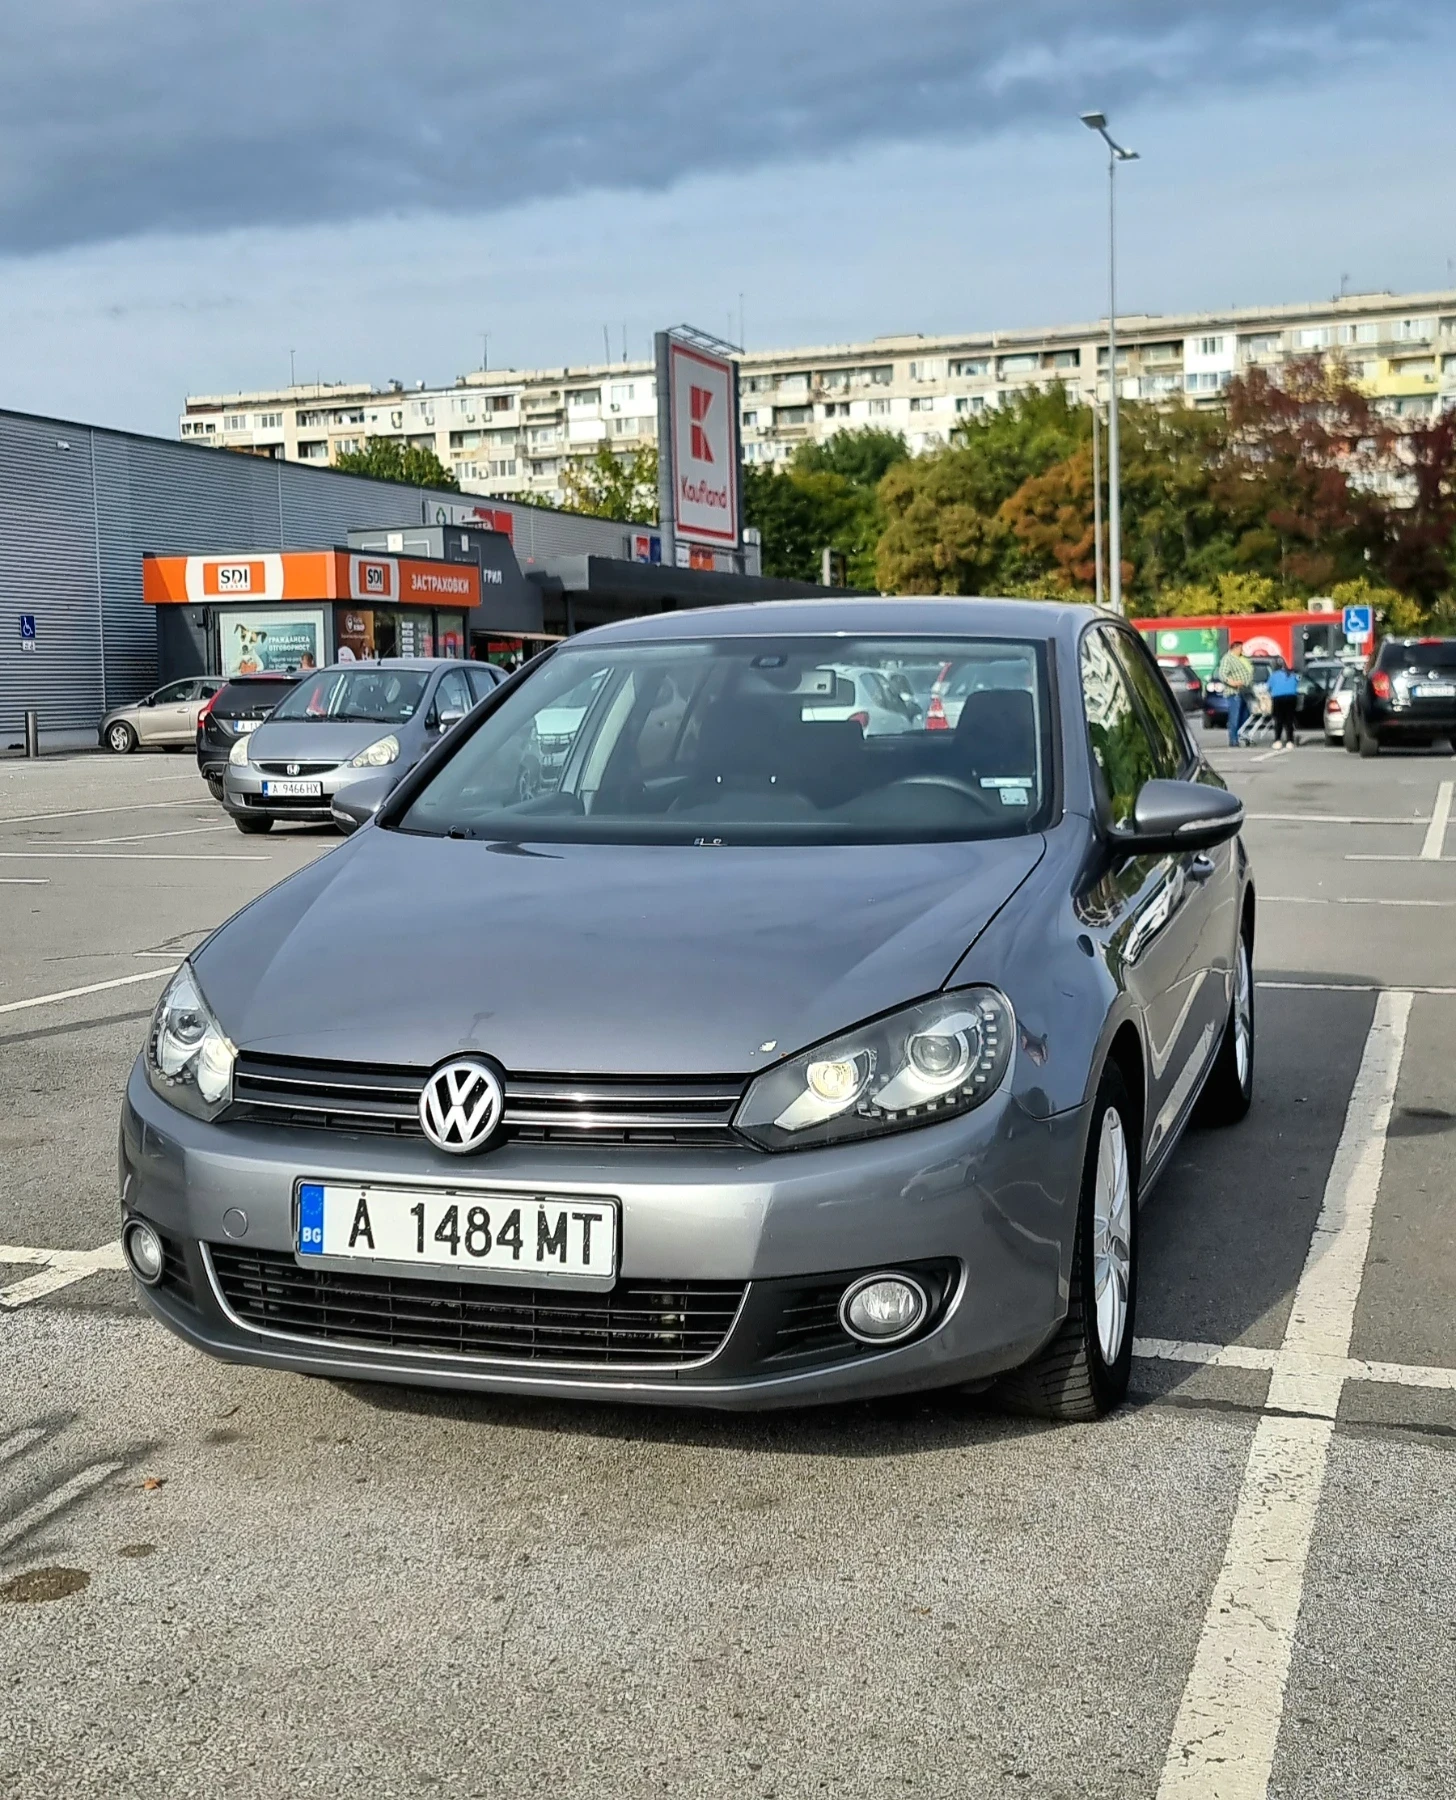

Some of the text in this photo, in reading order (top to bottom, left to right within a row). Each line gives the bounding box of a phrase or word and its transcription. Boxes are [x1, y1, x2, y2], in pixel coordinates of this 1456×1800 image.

[680, 475, 727, 508] Kaufland
[220, 568, 248, 584] SDI
[367, 568, 383, 585] SDI
[411, 573, 469, 595] ЗАСТРАХОВКИ
[483, 569, 503, 585] ГРИЛ
[272, 784, 279, 793] A
[348, 1198, 376, 1250] A
[302, 1227, 322, 1243] BG
